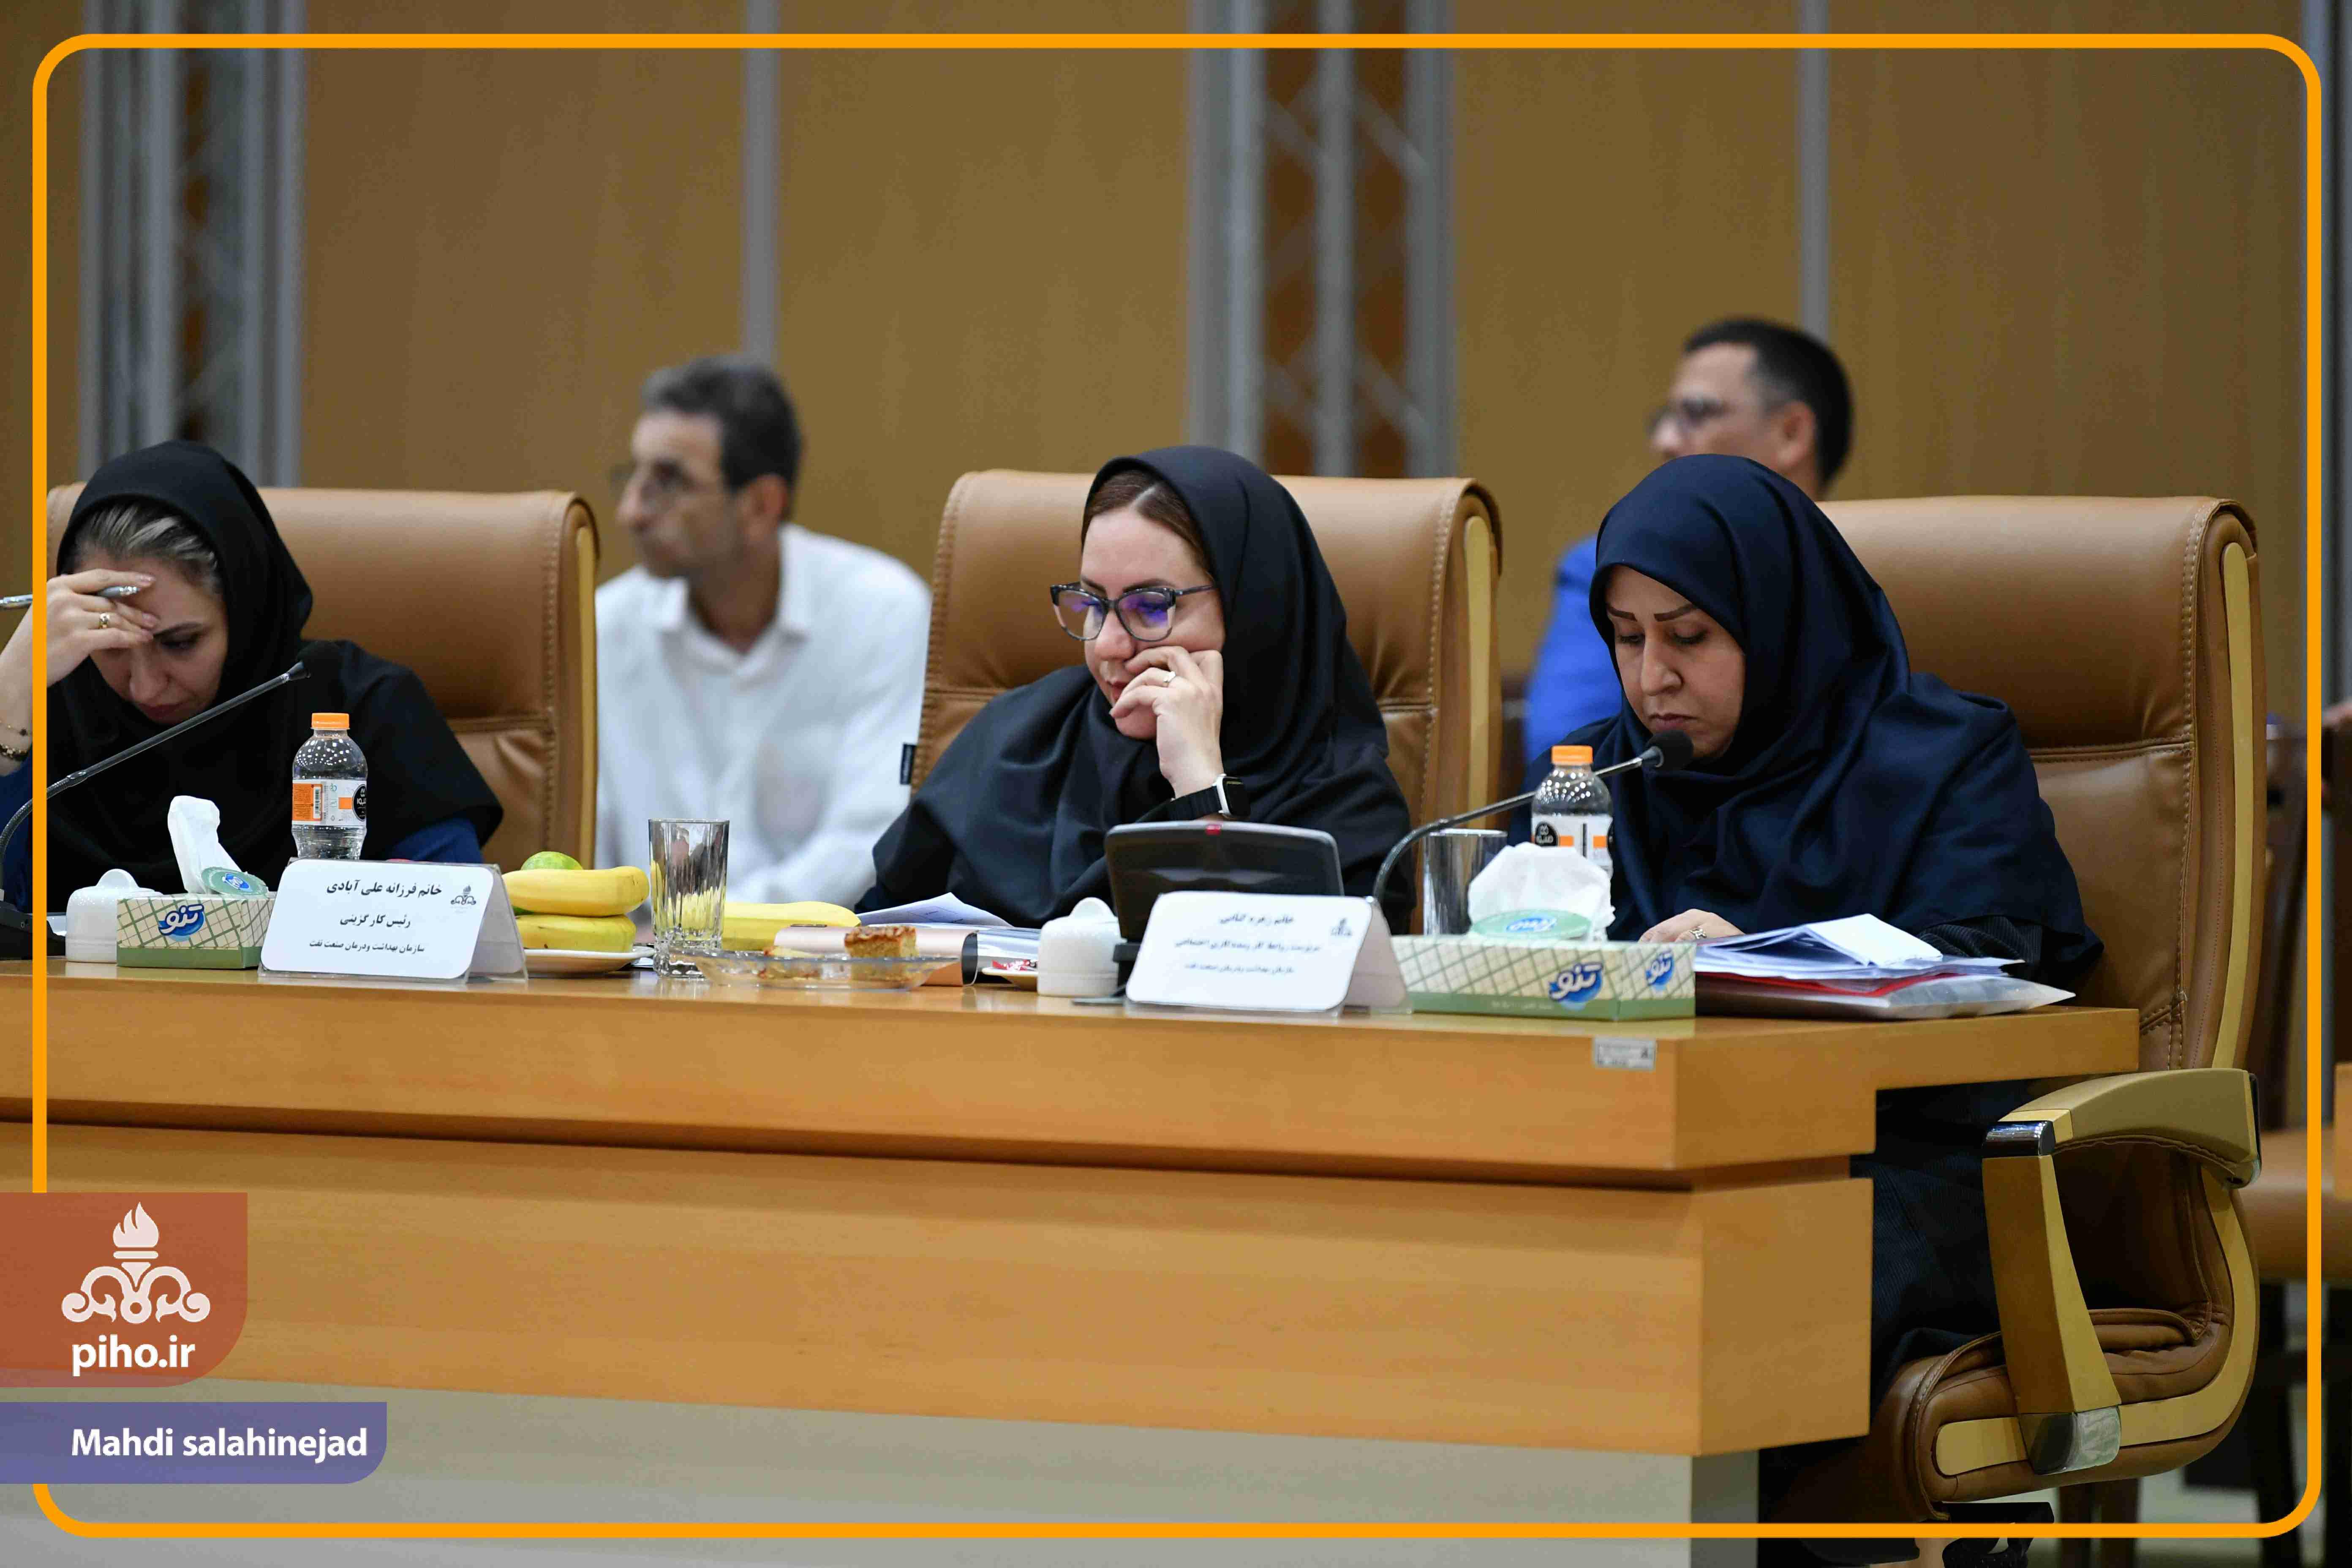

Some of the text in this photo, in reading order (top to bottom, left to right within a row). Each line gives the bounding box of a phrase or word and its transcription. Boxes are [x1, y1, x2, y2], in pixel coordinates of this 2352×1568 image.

[327, 879, 442, 898] خانم فرزانه علی آبادی
[158, 904, 204, 935] تنو
[387, 914, 411, 928] رئیس
[372, 942, 397, 952] بهداشت
[399, 943, 424, 954] سازمان
[1549, 962, 1603, 1002] تنو
